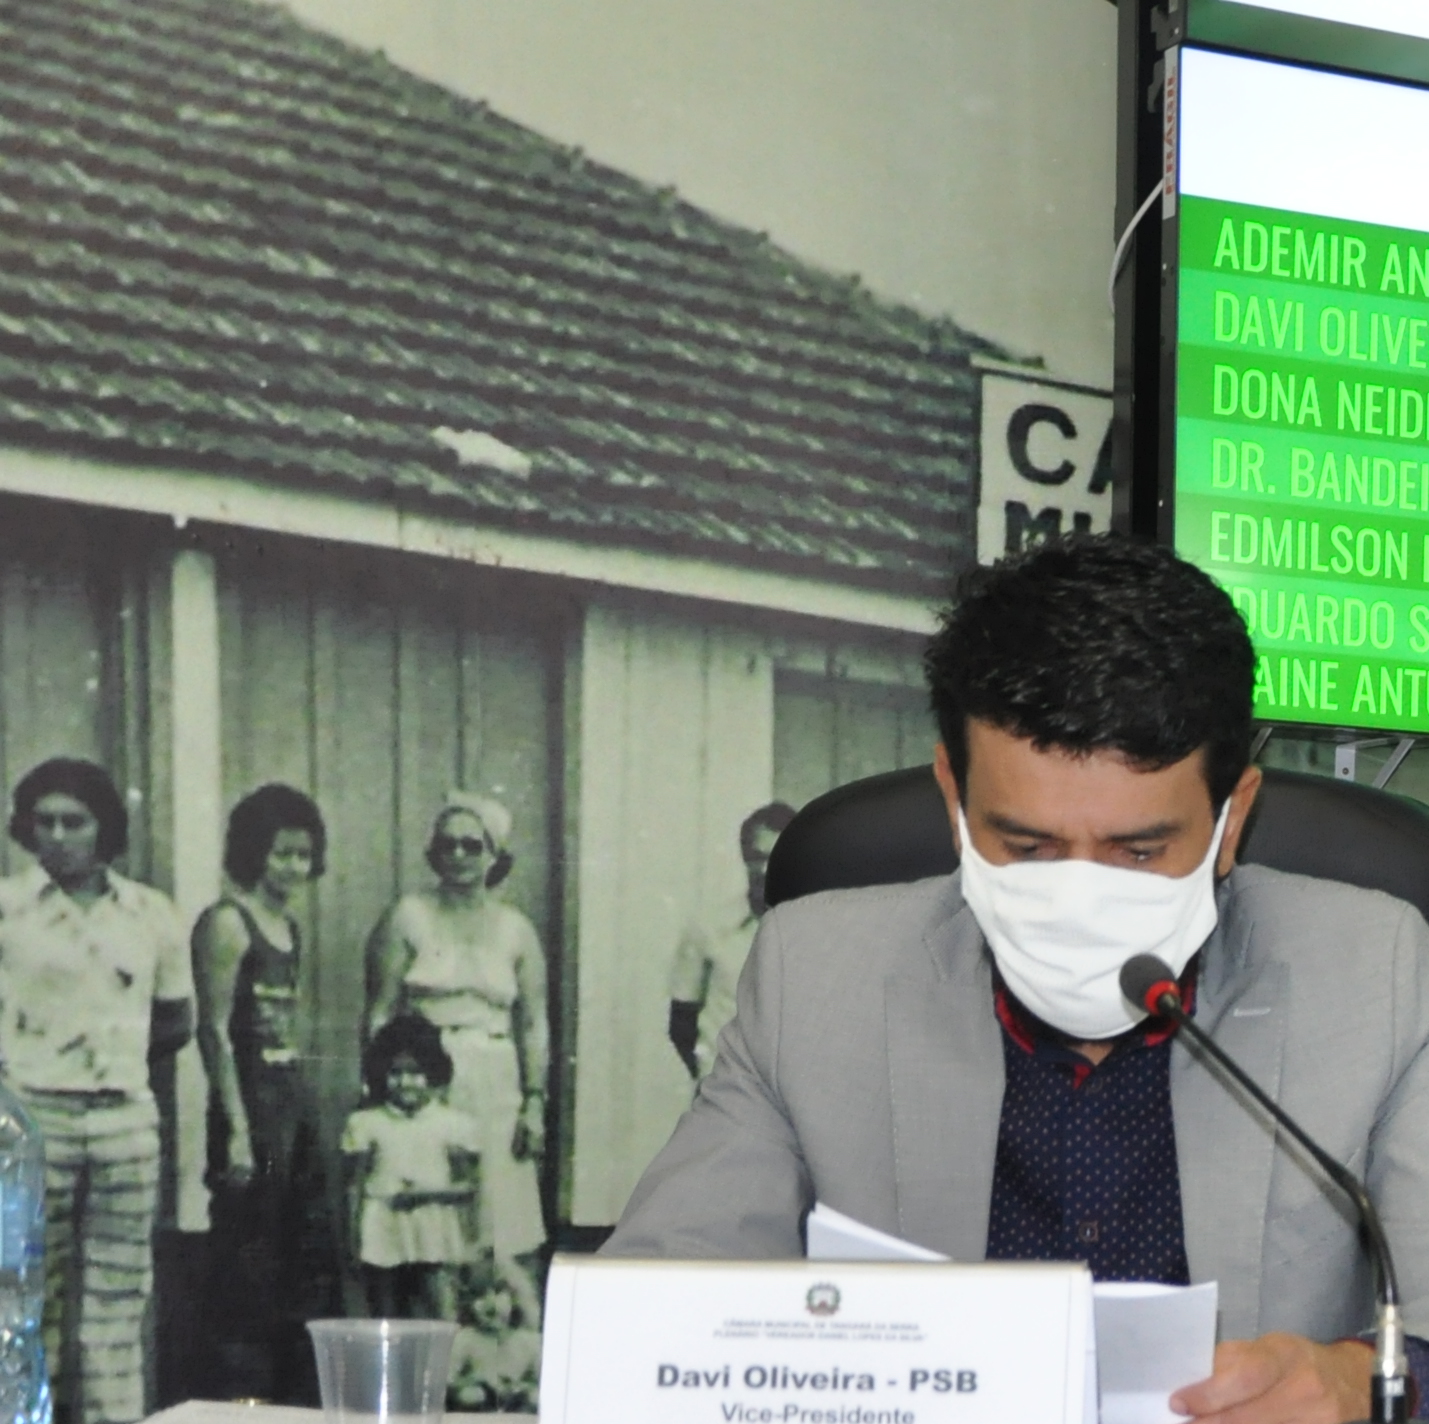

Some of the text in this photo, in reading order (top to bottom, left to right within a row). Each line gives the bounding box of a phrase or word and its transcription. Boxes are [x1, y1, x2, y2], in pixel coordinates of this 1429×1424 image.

[1213, 217, 1367, 289] ADEMIR
[1214, 290, 1304, 352] DAVI
[1213, 364, 1322, 427] DONA
[1212, 437, 1276, 495] DR.
[1210, 510, 1408, 582] EDMILSON
[1225, 584, 1395, 650] DUARDO
[657, 1364, 731, 1388] Davi
[743, 1365, 876, 1391] Oliveira
[908, 1368, 979, 1394] PSB
